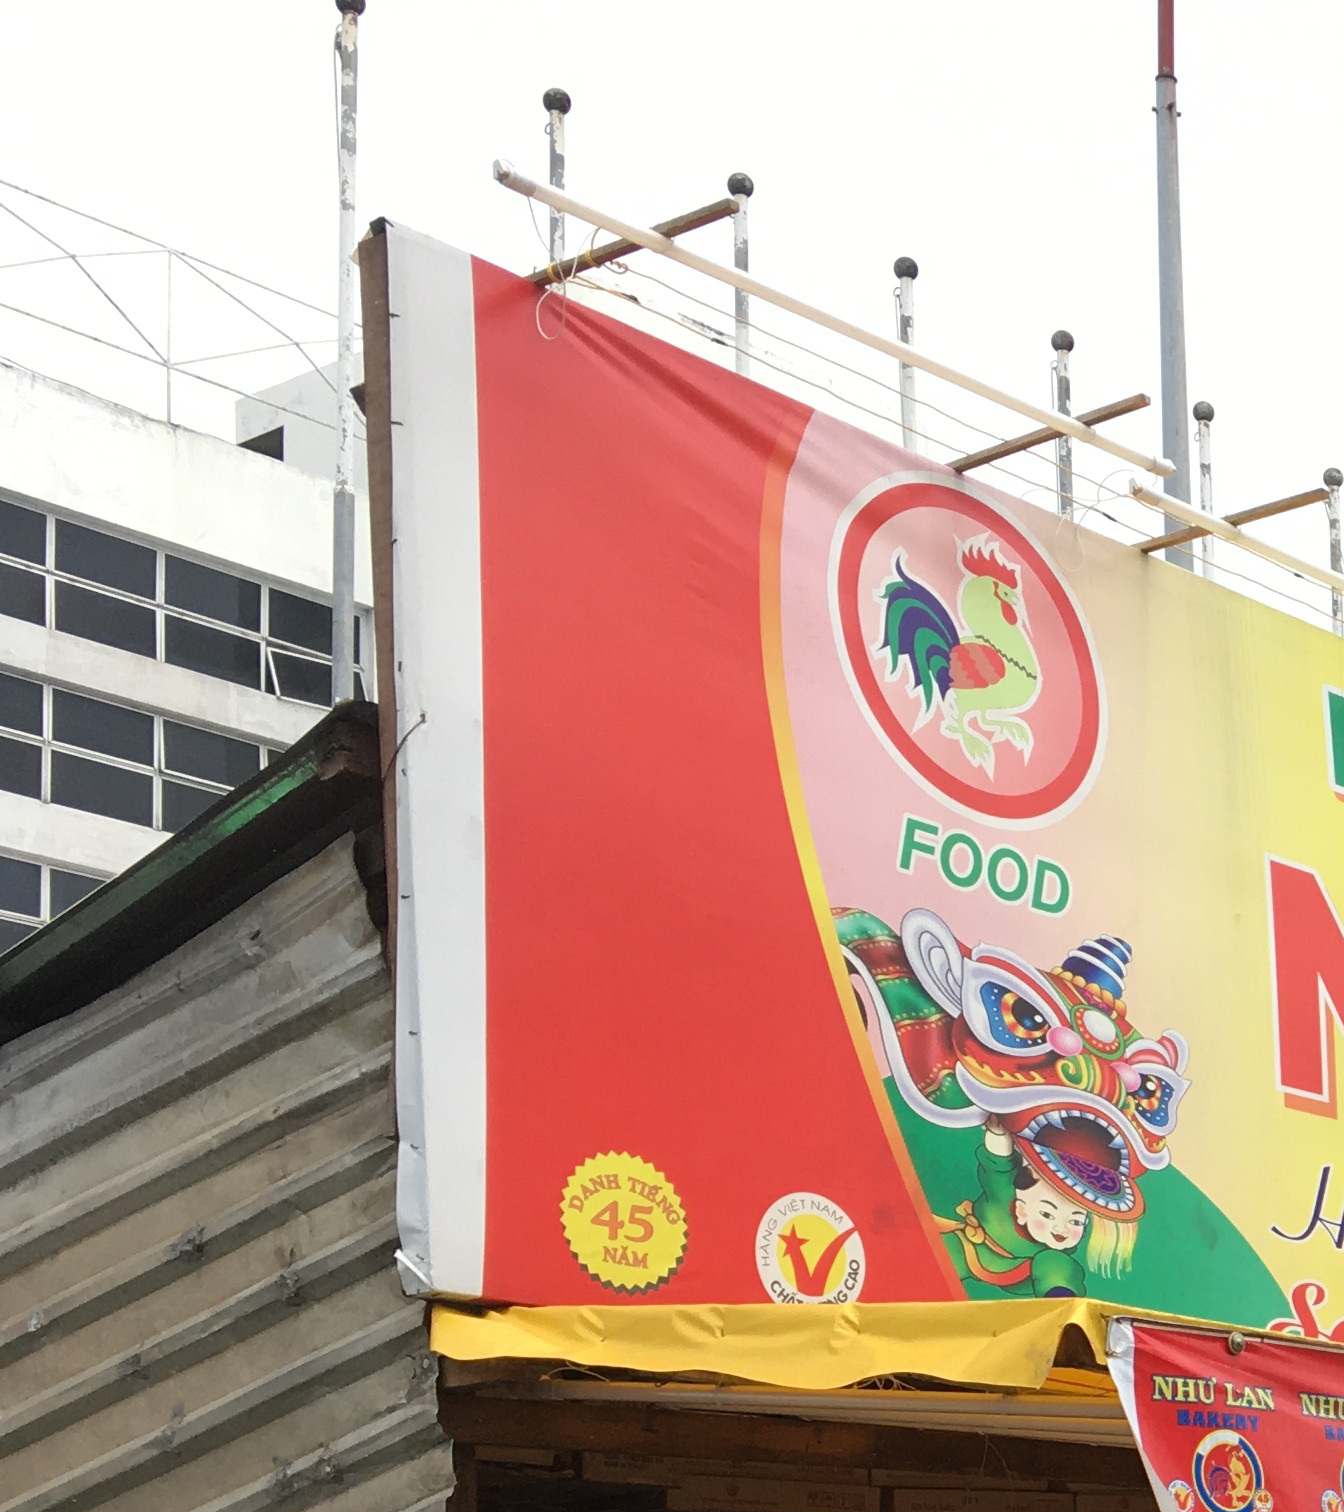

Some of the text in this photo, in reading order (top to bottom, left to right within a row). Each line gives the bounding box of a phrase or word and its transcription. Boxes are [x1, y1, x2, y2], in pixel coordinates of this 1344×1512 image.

[898, 818, 1070, 915] FOOD
[568, 1173, 681, 1226] DANH TIẾNG
[589, 1200, 655, 1243] 45
[761, 1199, 845, 1267] HÀNG VIỆT NAM
[601, 1245, 650, 1270] NĂM
[843, 1259, 862, 1292] CAO
[1151, 1374, 1277, 1411] NHƯ LAN
[1176, 1409, 1260, 1432] BAKERY
